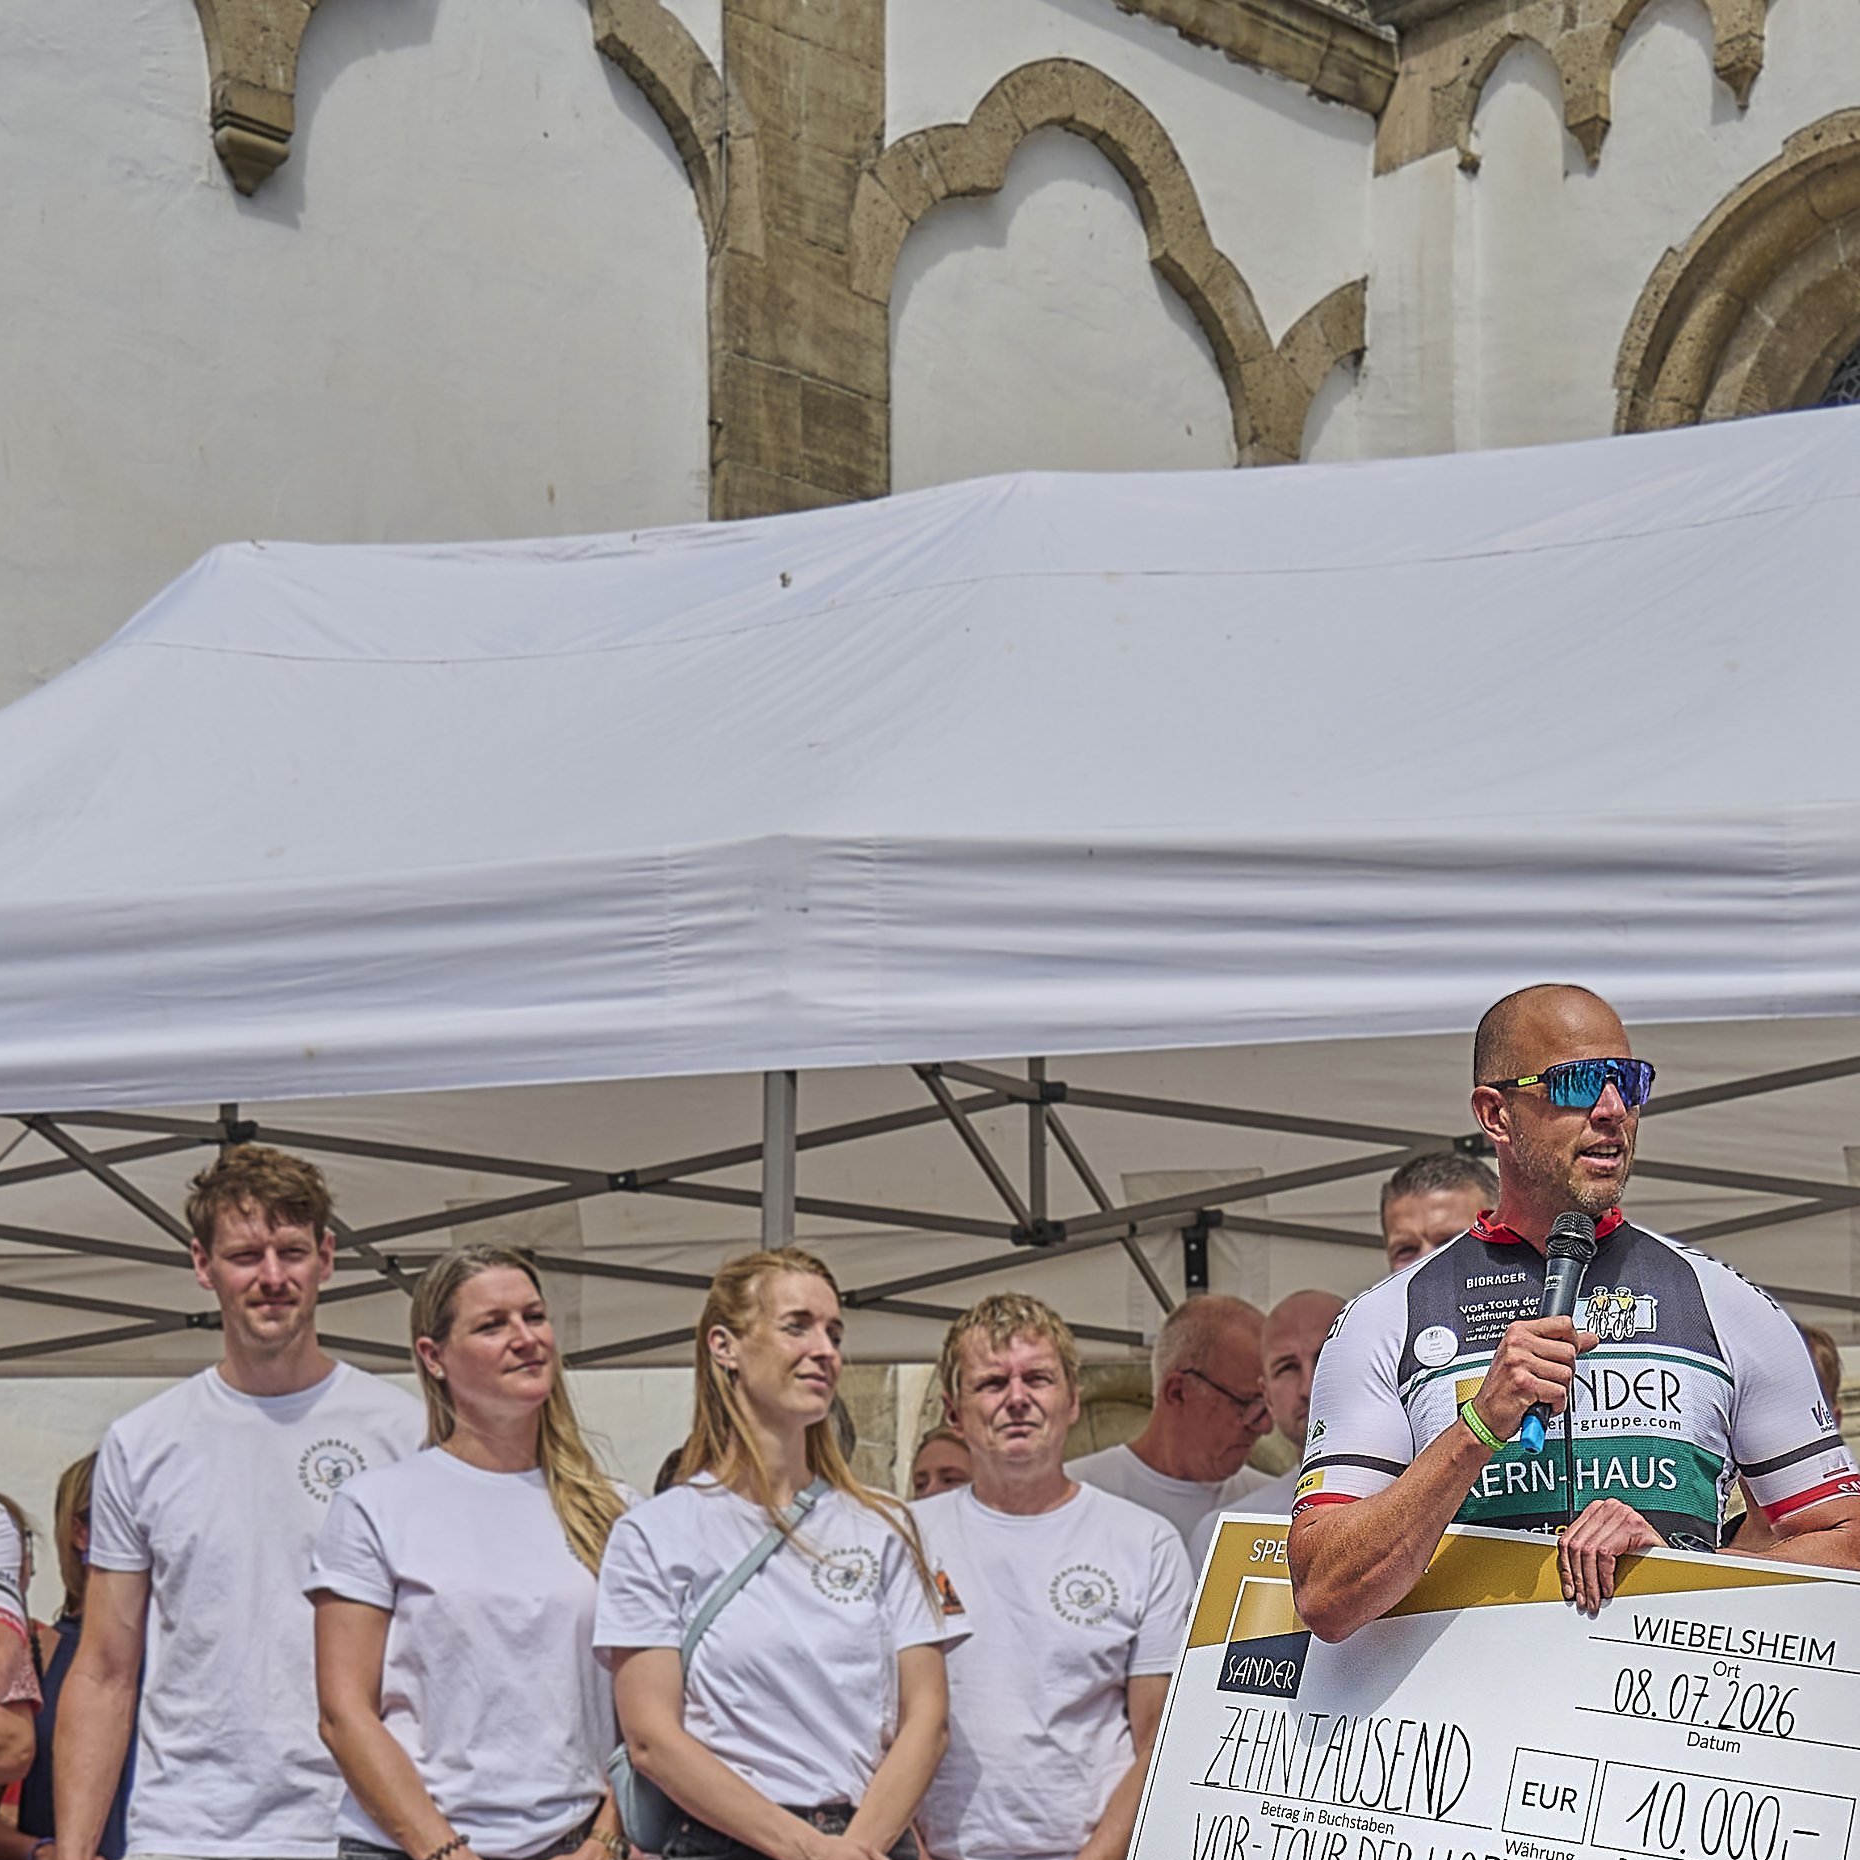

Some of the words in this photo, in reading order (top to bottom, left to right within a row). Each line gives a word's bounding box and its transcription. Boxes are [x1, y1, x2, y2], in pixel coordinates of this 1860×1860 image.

[1466, 1273, 1526, 1288] BIORACER
[1459, 1299, 1516, 1315] VOR-TOUR
[1519, 1297, 1540, 1307] der
[1466, 1310, 1515, 1323] Hoffnung
[1634, 1615, 1836, 1667] WIEBELSHEIM
[1226, 1653, 1298, 1690] SANDER
[1713, 1660, 1741, 1680] Ort
[1687, 1731, 1741, 1754] Datum
[1204, 1706, 1472, 1820] ZEHNTAUSEND
[1521, 1782, 1577, 1814] EUR
[1260, 1801, 1301, 1824] Betrag
[1303, 1806, 1315, 1822] in
[1318, 1809, 1395, 1835] Buchstaben
